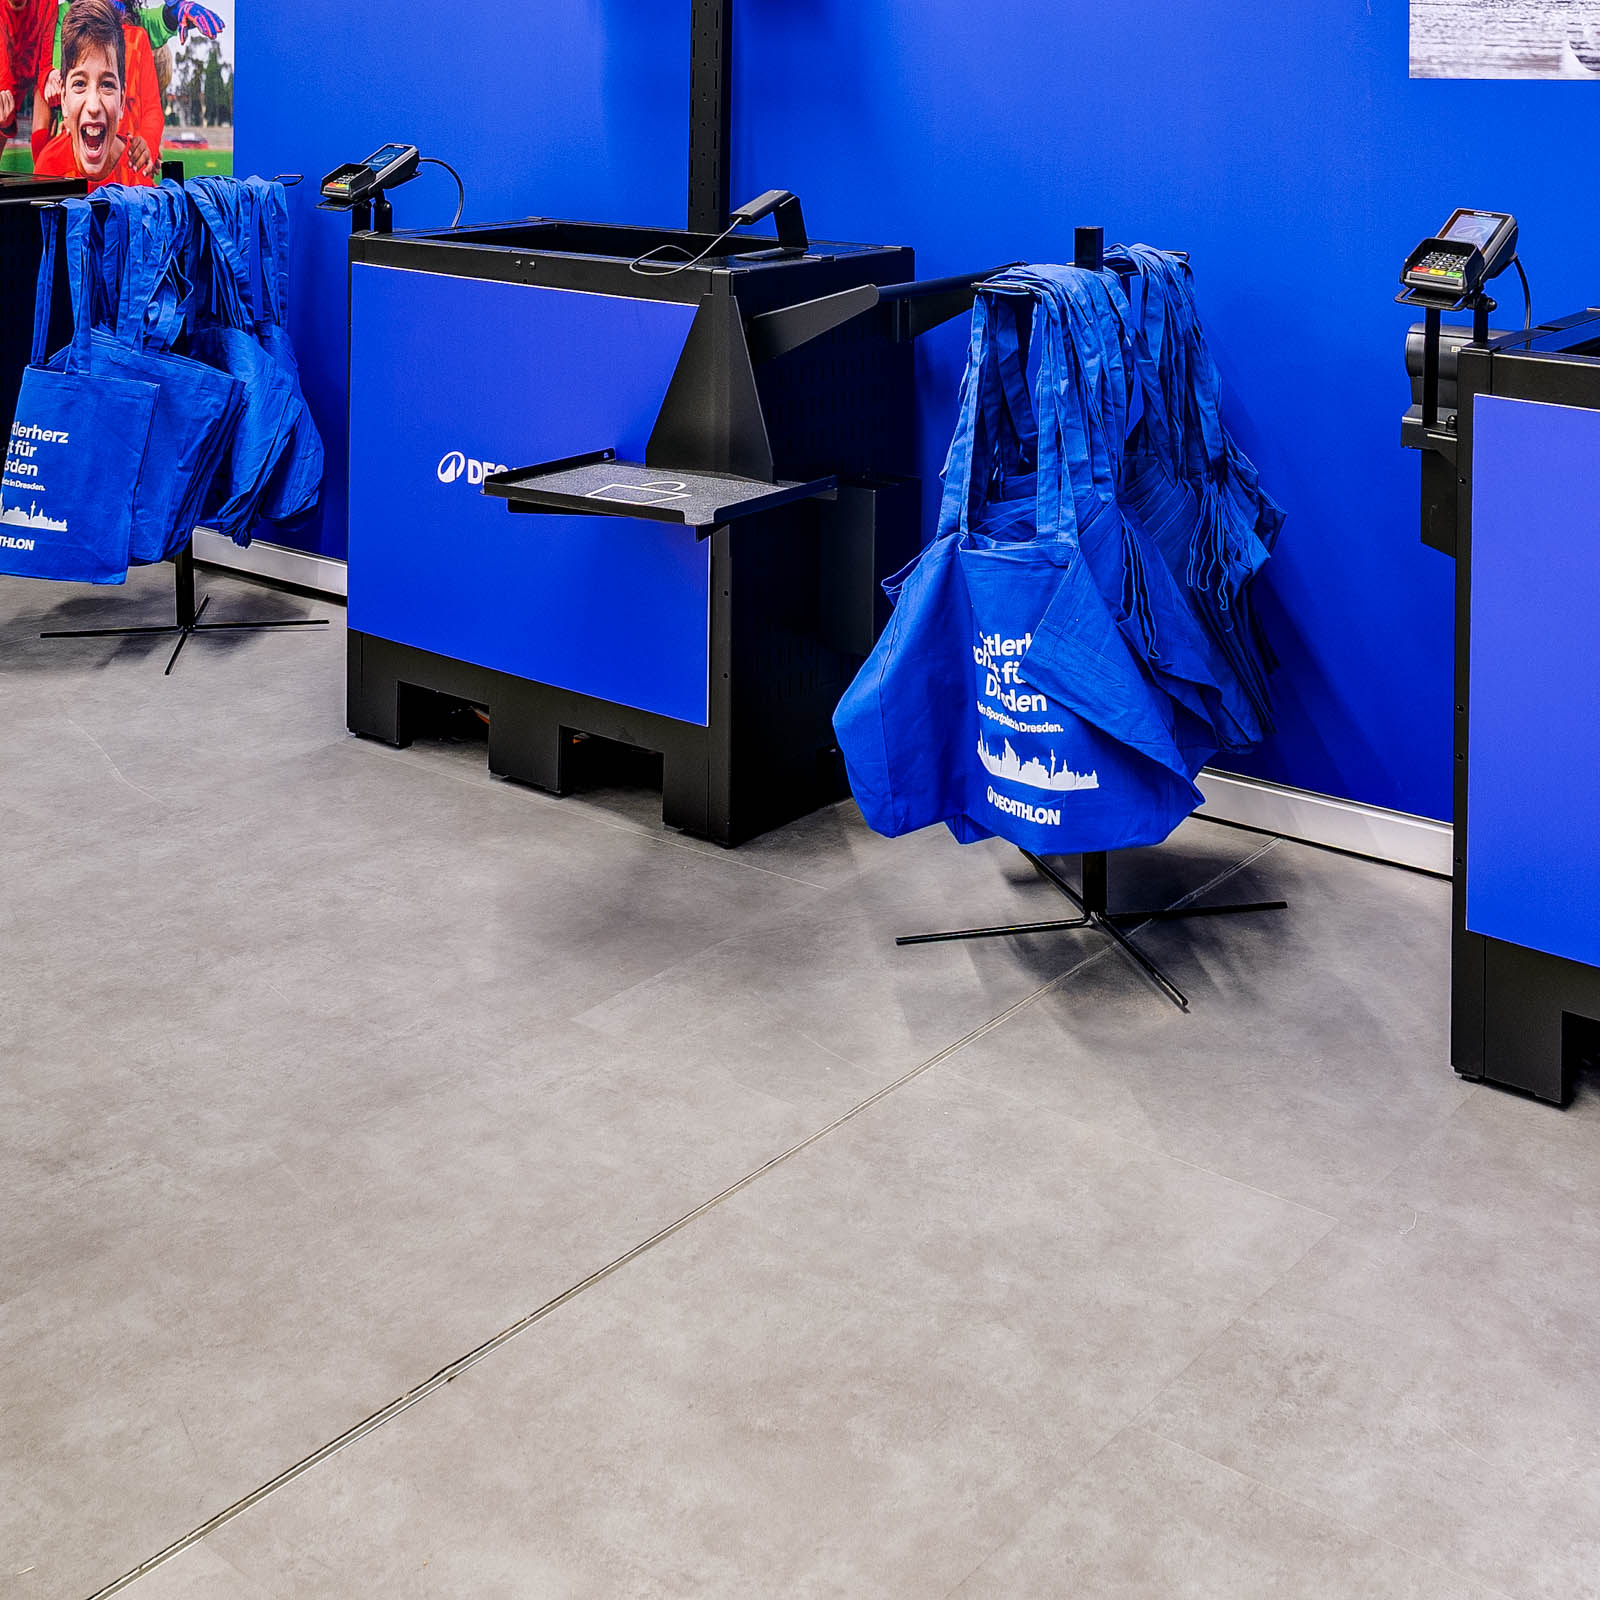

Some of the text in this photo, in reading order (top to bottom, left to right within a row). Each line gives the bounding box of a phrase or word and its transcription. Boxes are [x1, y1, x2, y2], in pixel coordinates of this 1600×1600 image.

[15, 440, 37, 458] für
[1019, 721, 1064, 733] Dresden.
[993, 791, 1061, 826] DECATHLON
